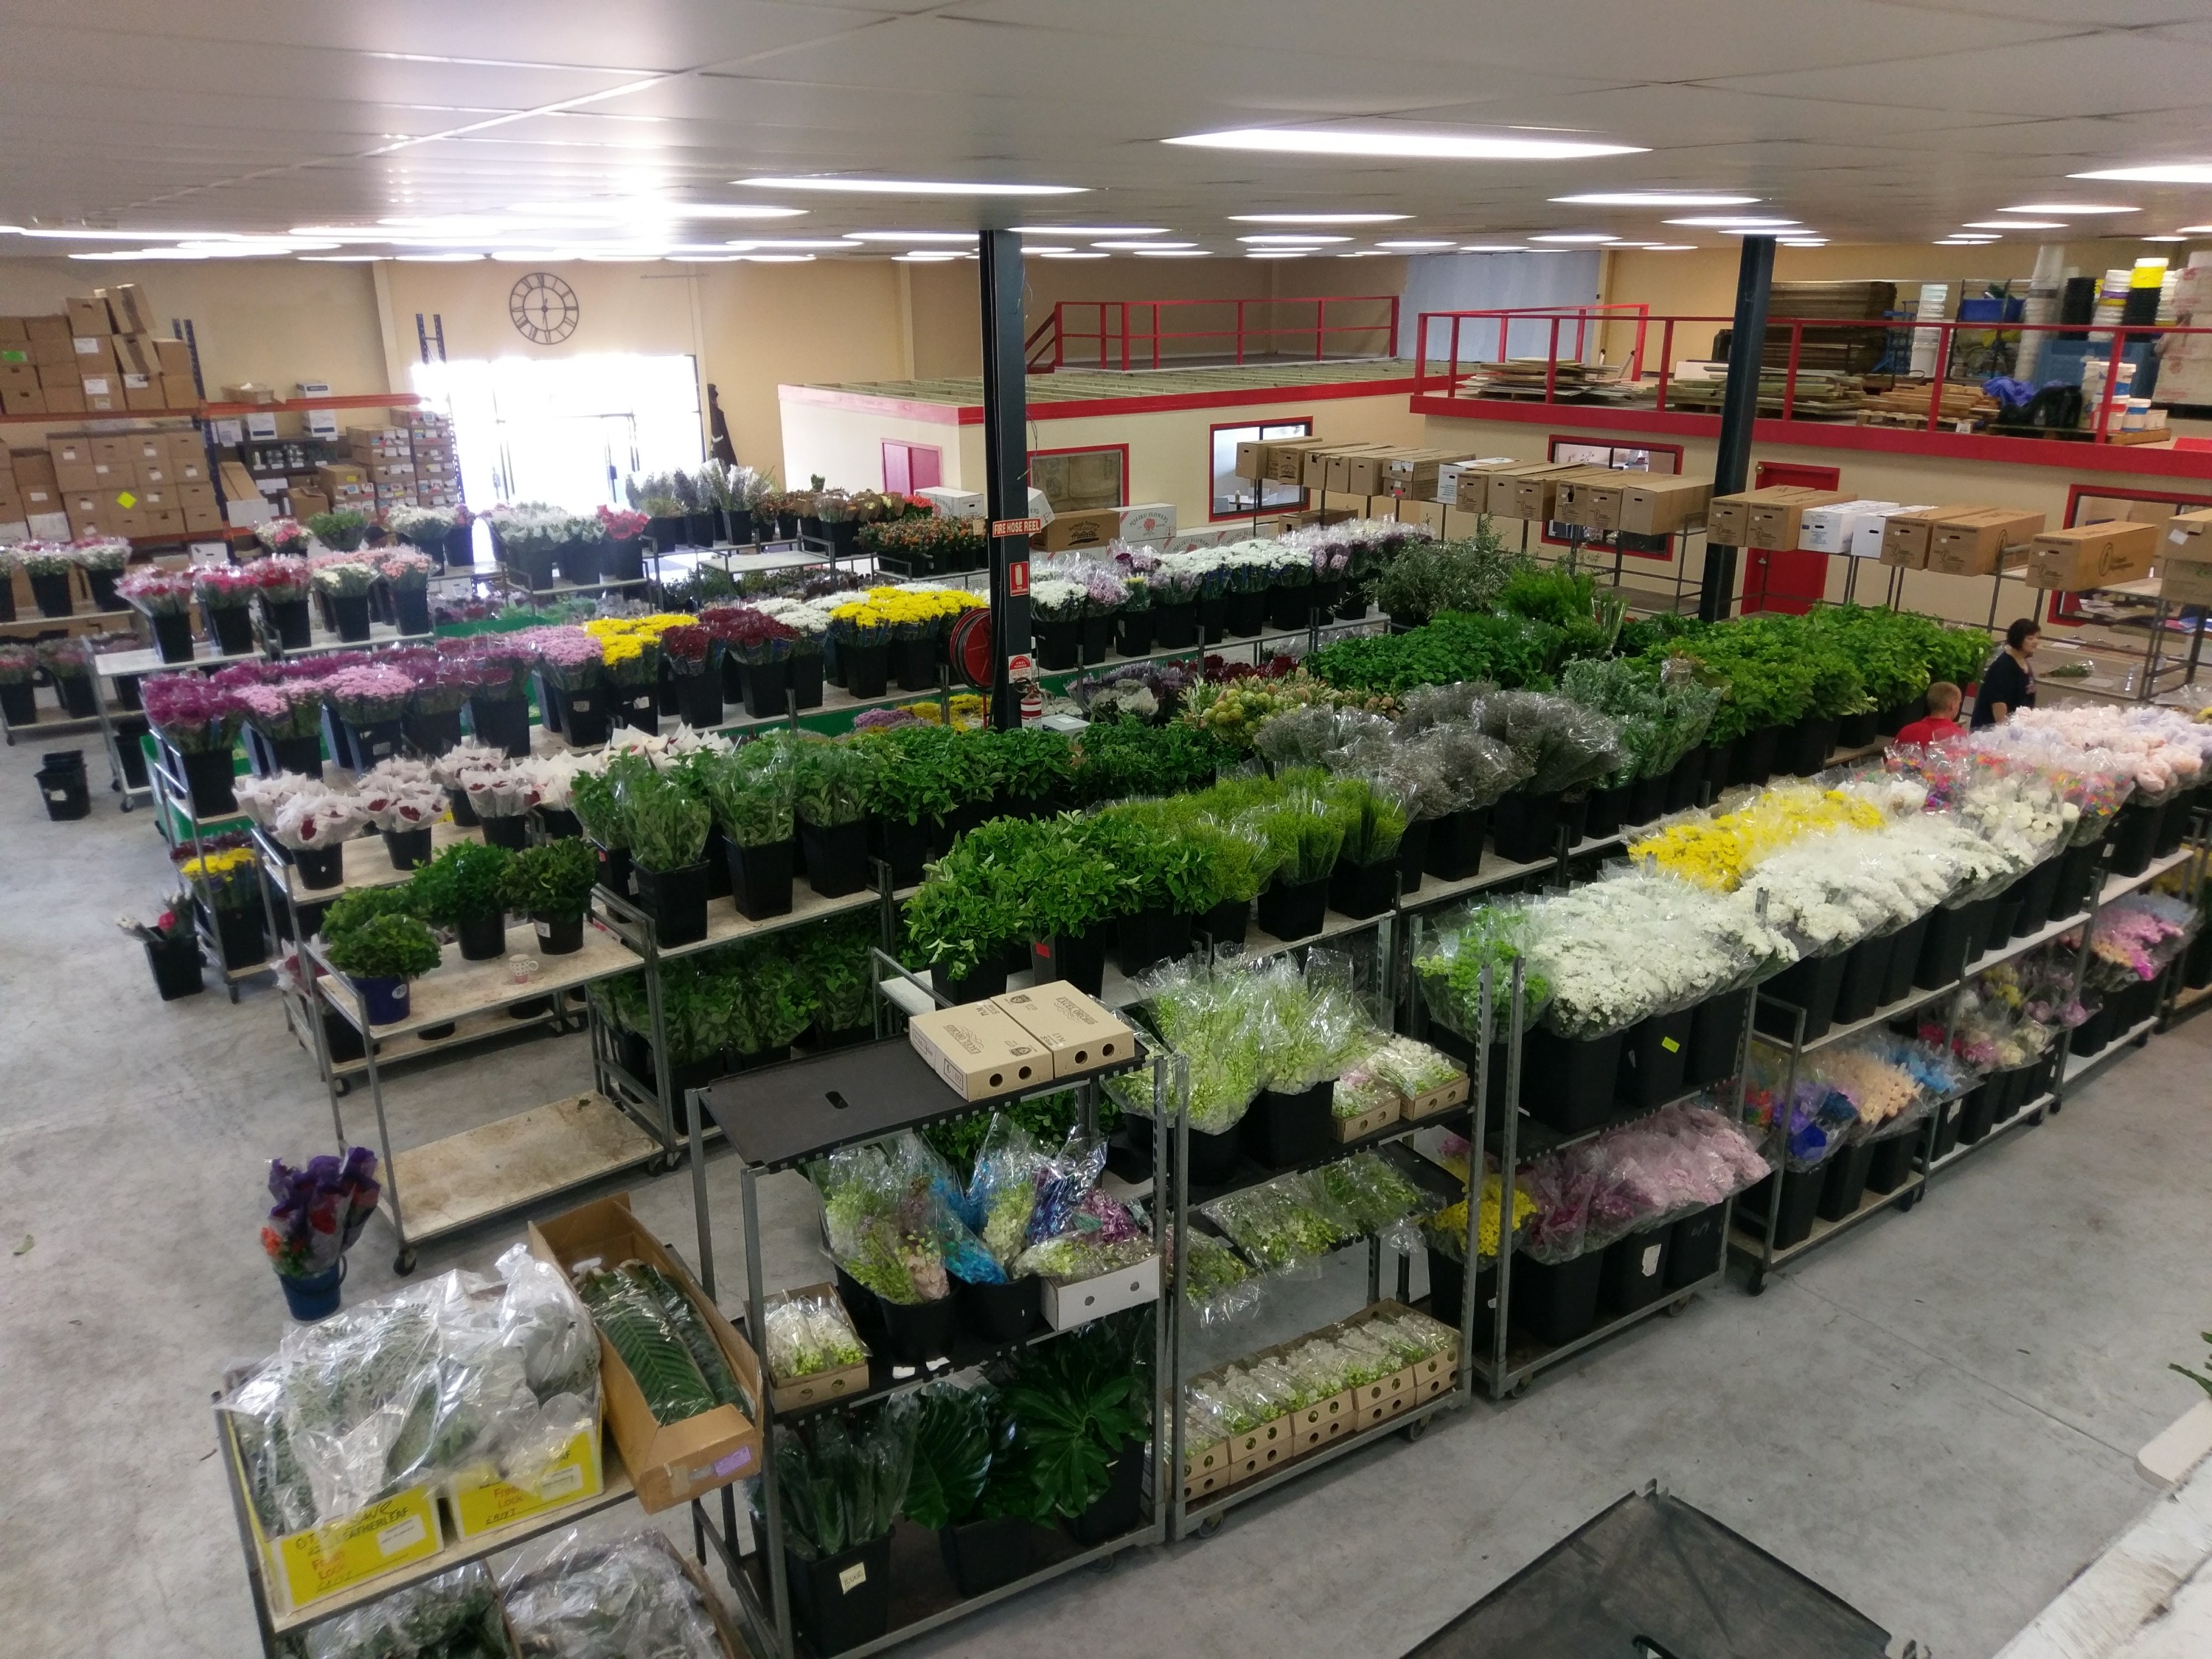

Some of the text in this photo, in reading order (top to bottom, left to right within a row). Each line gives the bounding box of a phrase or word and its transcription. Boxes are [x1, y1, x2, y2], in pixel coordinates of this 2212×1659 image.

[1148, 512, 1169, 524] FLOWERS
[994, 520, 1040, 535] FIRE HOSE REEL
